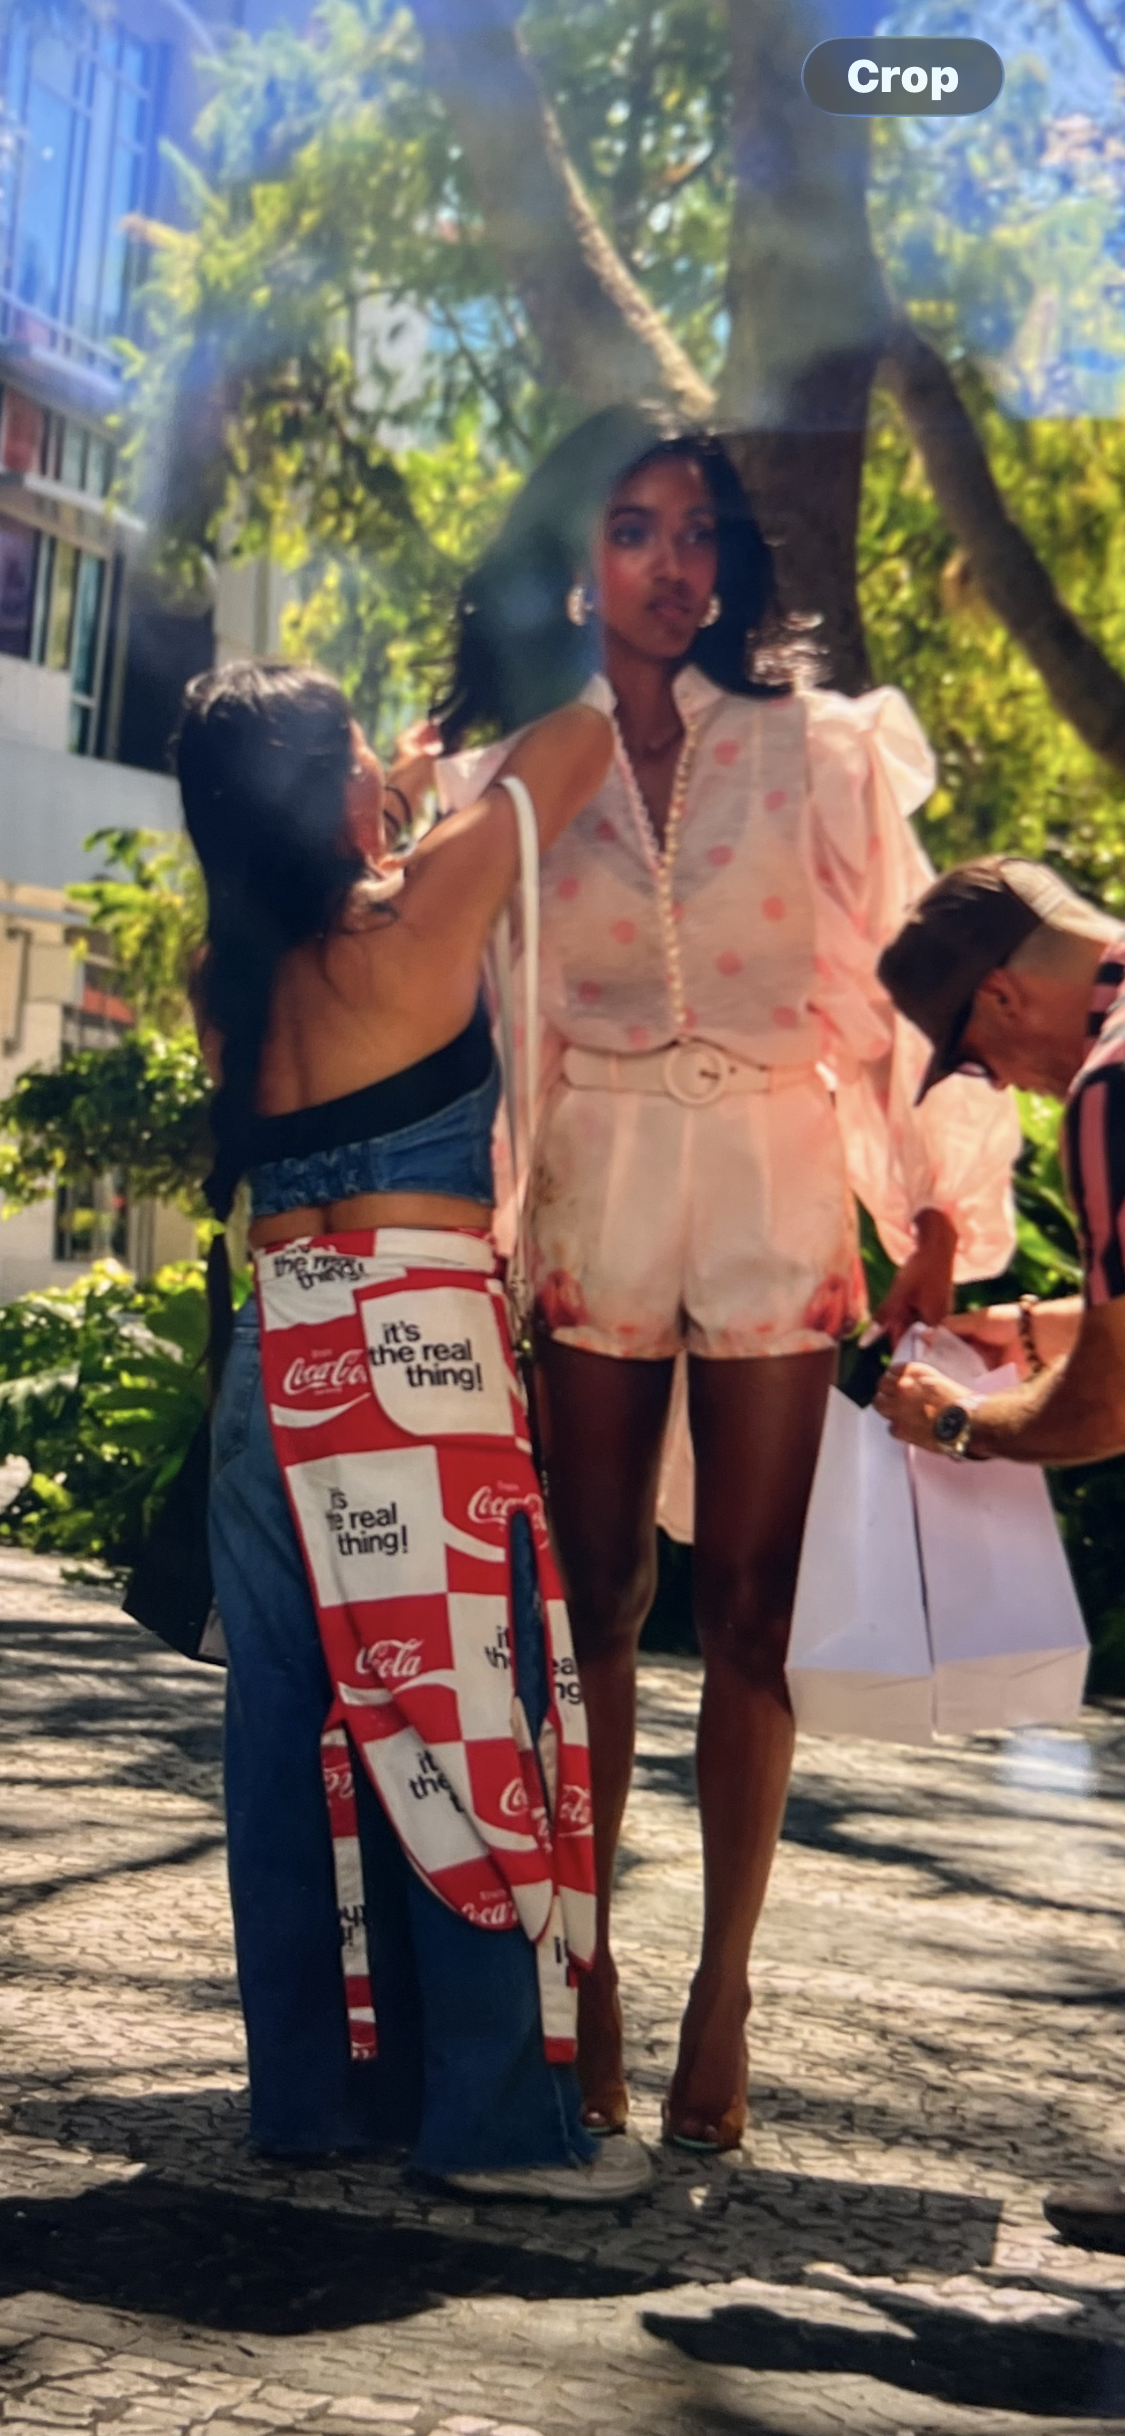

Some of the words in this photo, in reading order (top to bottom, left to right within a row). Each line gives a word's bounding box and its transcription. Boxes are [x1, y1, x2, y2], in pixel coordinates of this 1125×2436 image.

[382, 1320, 421, 1344] it's
[368, 1344, 416, 1366] the
[421, 1338, 473, 1361] real
[405, 1362, 484, 1392] thing!
[348, 1501, 397, 1529] real
[337, 1525, 408, 1556] thing!
